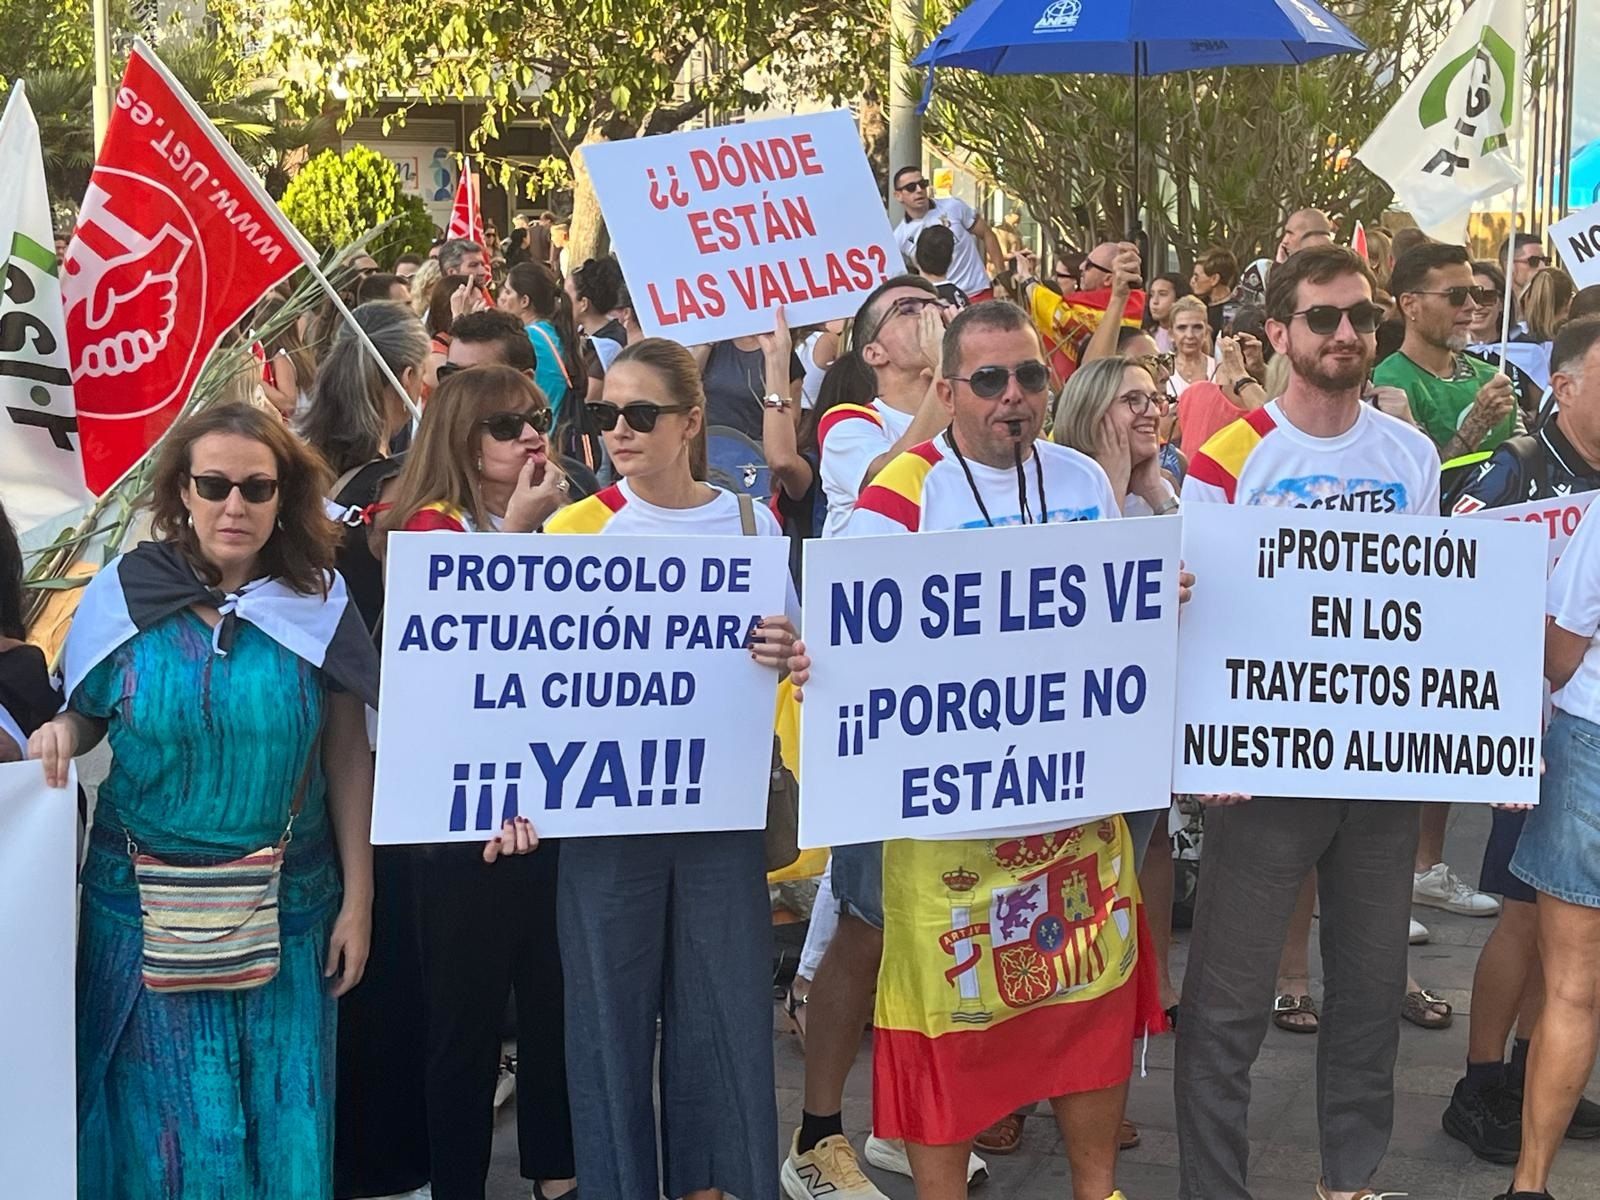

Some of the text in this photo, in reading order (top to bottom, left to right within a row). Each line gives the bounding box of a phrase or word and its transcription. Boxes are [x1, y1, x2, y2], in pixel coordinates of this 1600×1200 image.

[1034, 15, 1079, 29] ANPE
[116, 86, 283, 265] www.UGT.es
[646, 134, 823, 209] ¿¿ DÓNDE
[687, 191, 816, 254] ESTÁN
[647, 244, 887, 326] LAS VALLAS?
[428, 554, 752, 593] PROTOCOLO DE
[1258, 527, 1477, 579] ¡¡PROTECCIÓN
[398, 605, 651, 652] ACTUACIÓN
[830, 558, 1163, 647] NO SE LES VE
[1311, 595, 1422, 642] EN LOS
[473, 671, 696, 709] LA CIUDAD
[838, 664, 1147, 758] ¡¡PORQUE NO
[1225, 658, 1500, 711] TRAYECTOS PARA
[1183, 723, 1535, 778] NUESTRO ALUMNADO!!
[449, 738, 706, 832] ¡¡¡YA!!!
[901, 744, 1085, 819] ESTÁN!!
